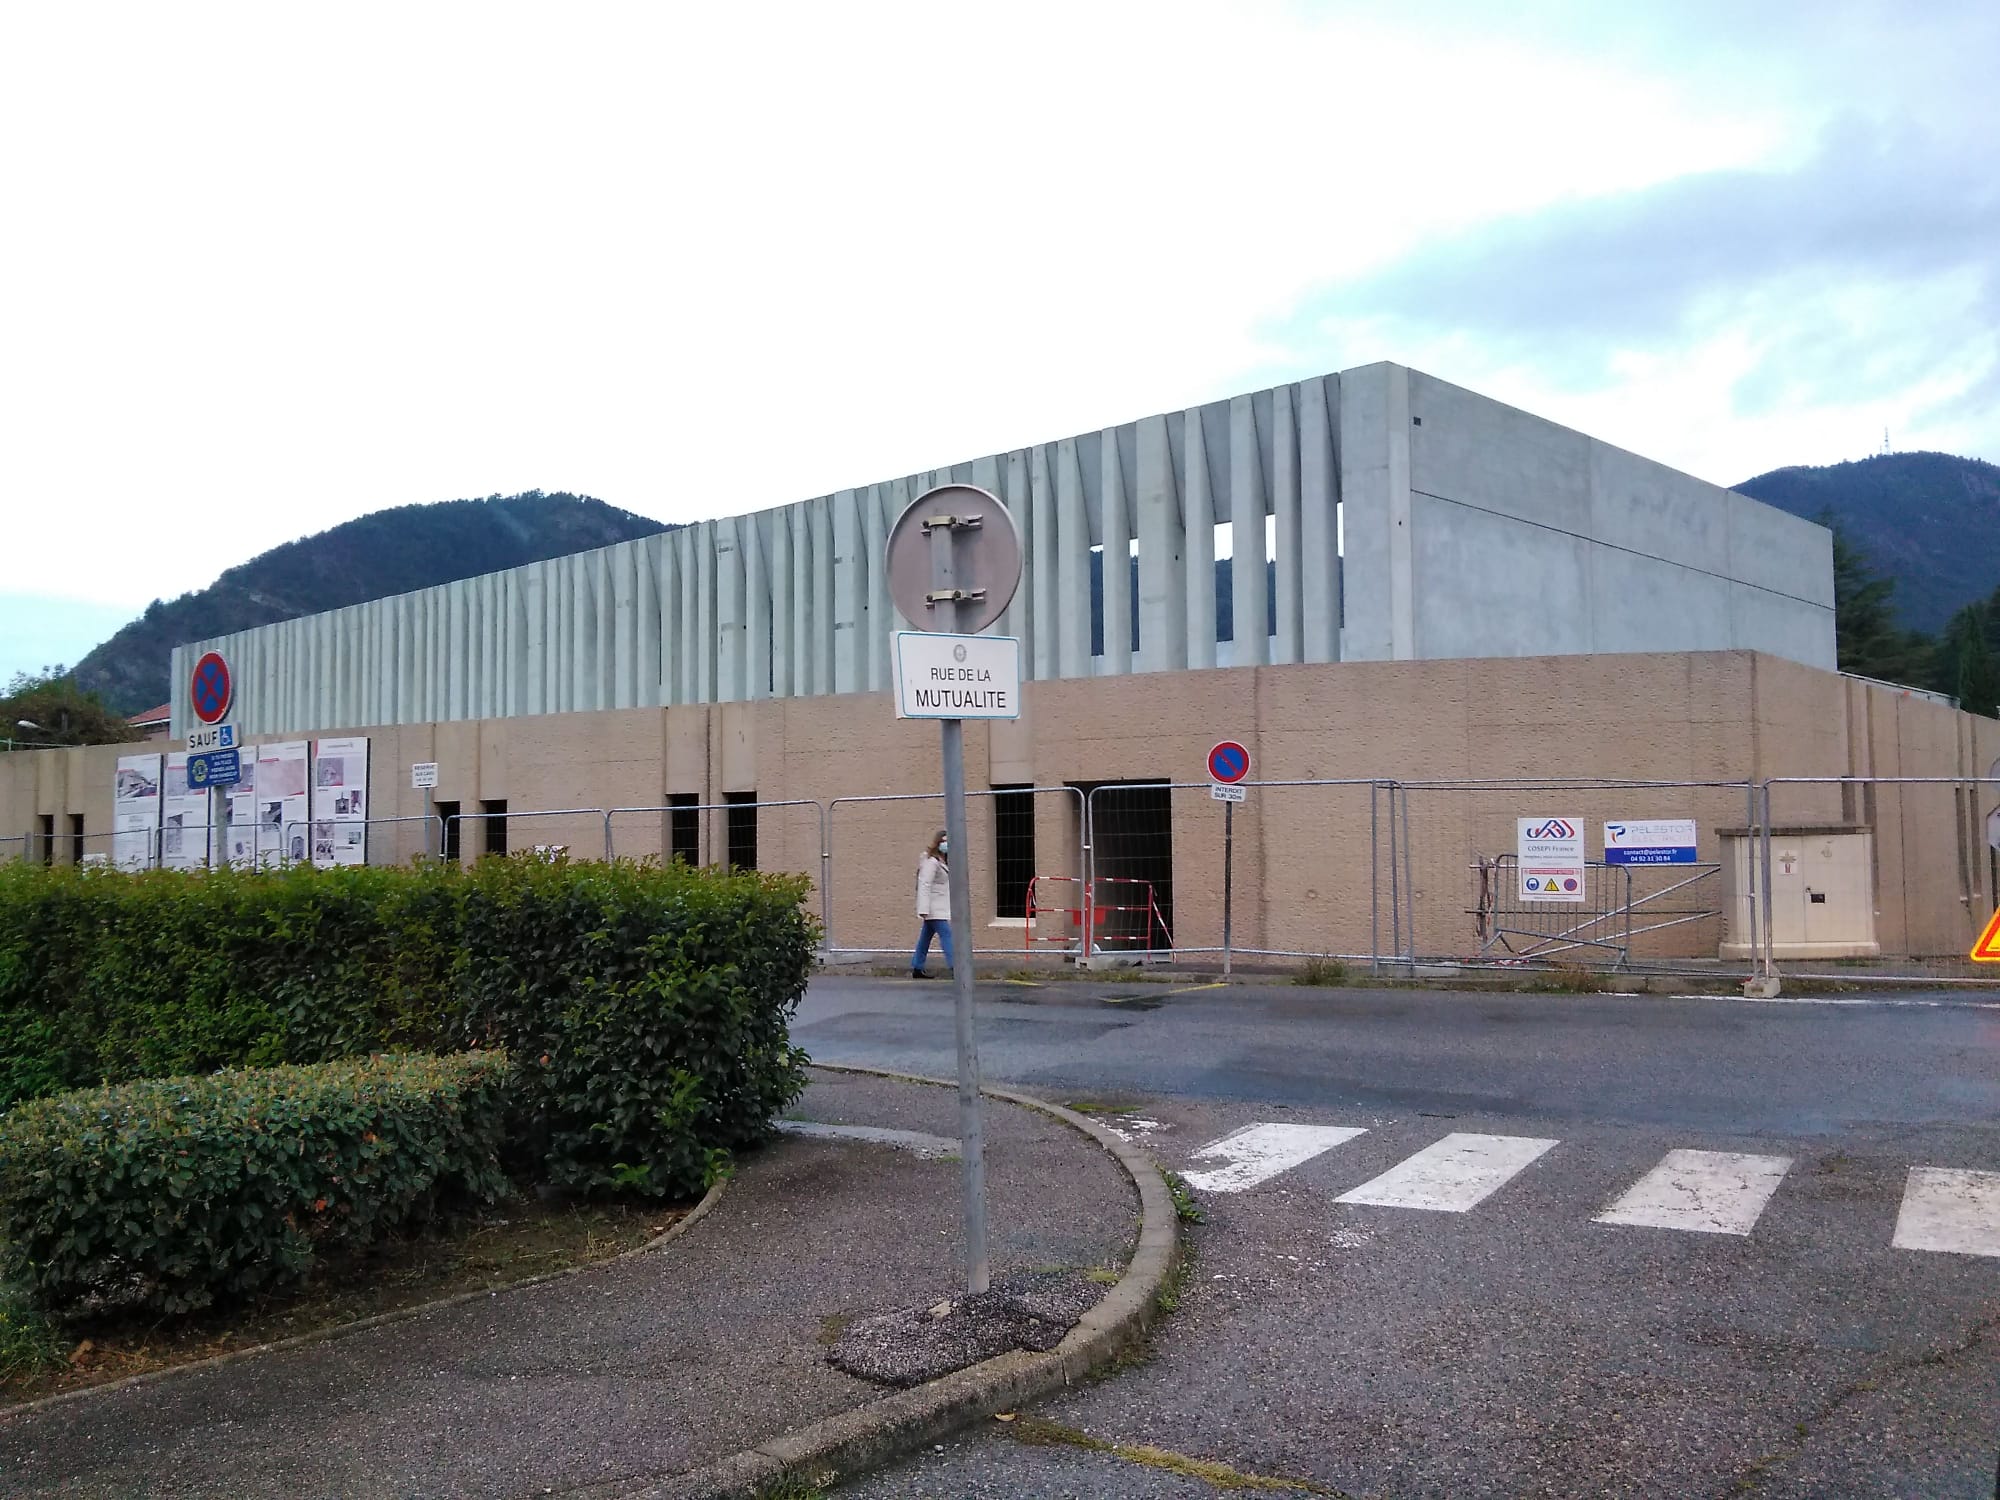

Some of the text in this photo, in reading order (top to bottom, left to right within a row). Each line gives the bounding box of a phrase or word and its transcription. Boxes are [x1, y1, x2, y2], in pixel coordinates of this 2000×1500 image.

[930, 667, 991, 682] RUE DE LA
[915, 689, 1006, 708] MUTUALITE
[189, 731, 218, 748] SAUF
[1215, 786, 1242, 794] INTERDIT
